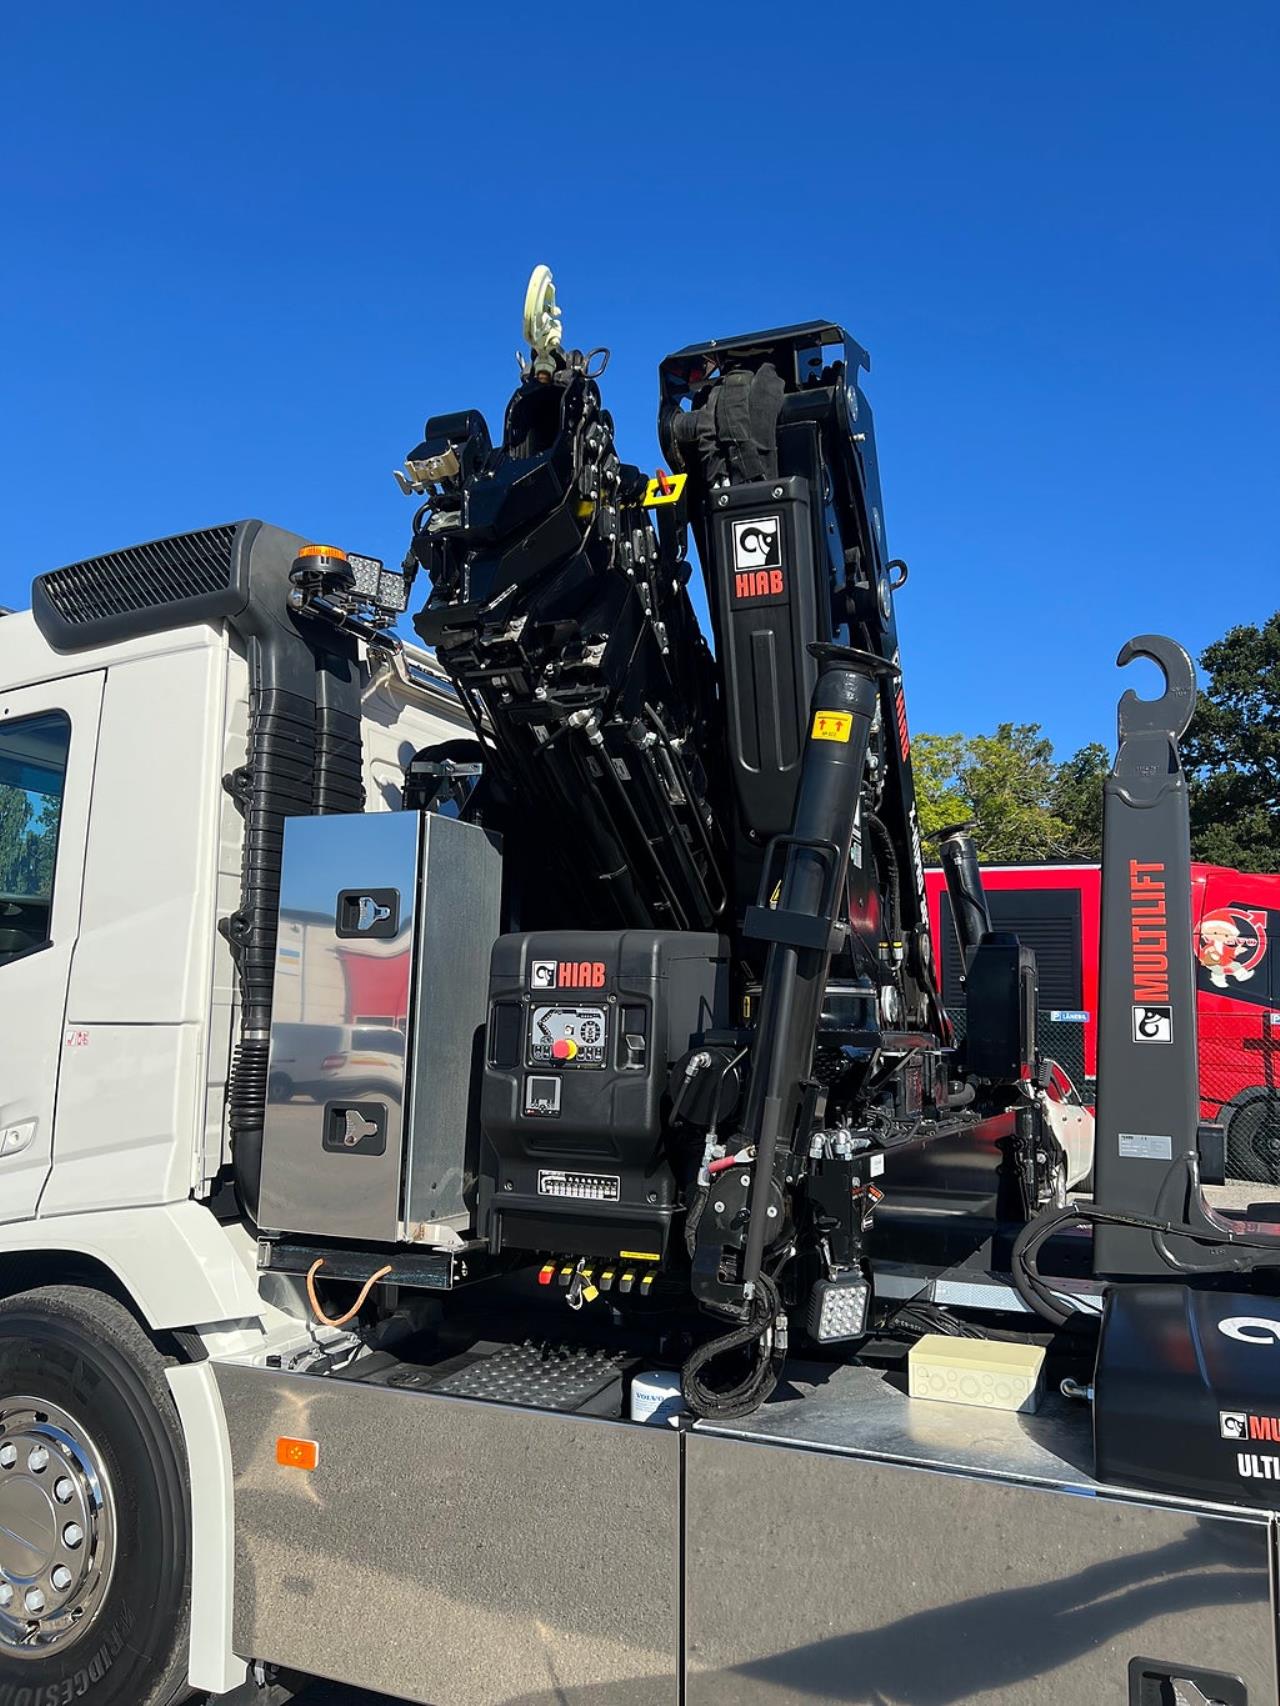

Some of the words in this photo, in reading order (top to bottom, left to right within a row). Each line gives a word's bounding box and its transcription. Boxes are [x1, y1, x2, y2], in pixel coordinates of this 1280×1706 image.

[735, 569, 783, 598] HIAB
[1130, 859, 1169, 1002] MULTILIFT
[558, 961, 606, 988] HIAB
[635, 1391, 665, 1402] VOLVO
